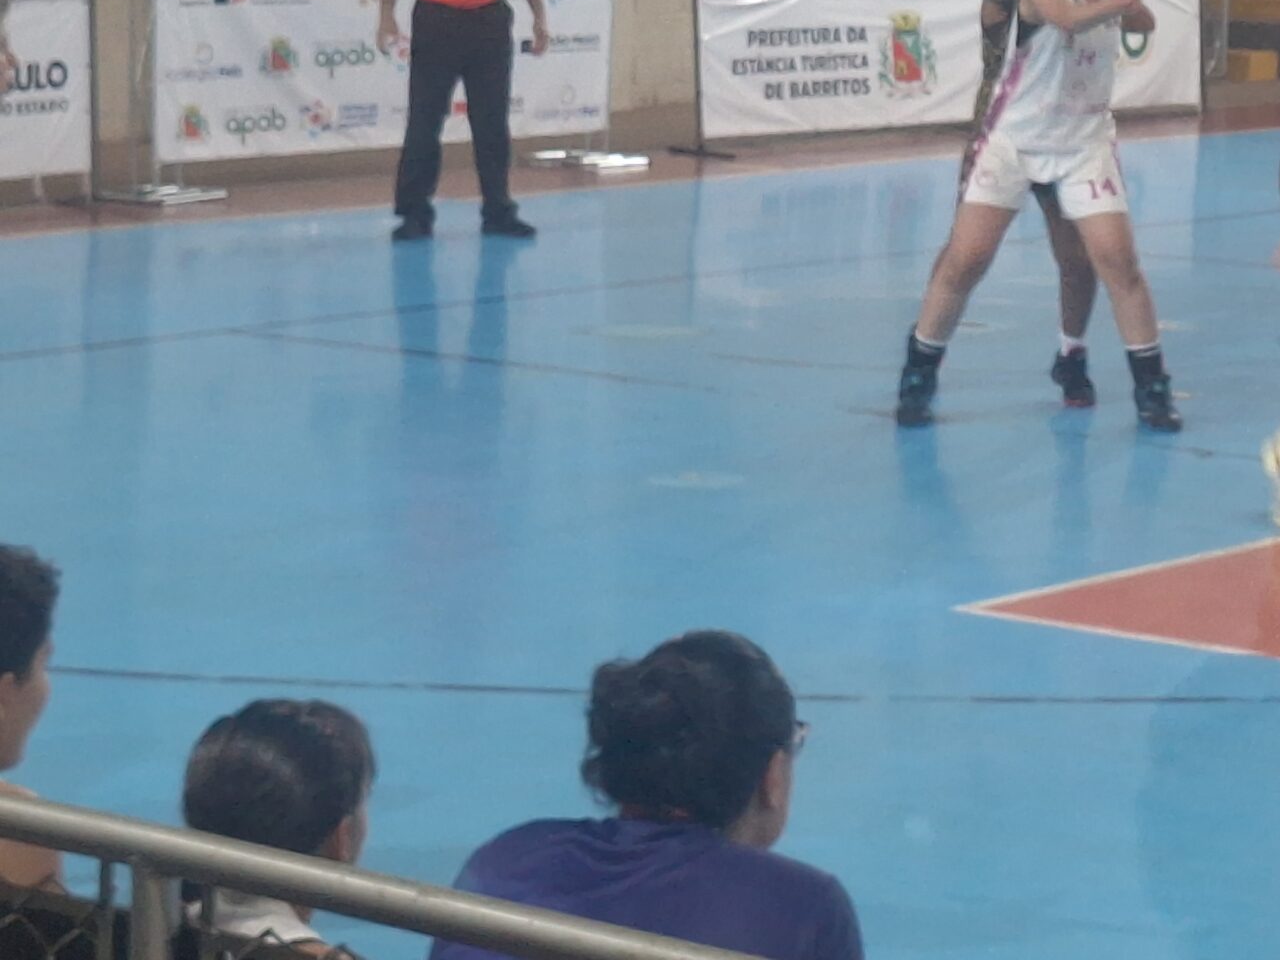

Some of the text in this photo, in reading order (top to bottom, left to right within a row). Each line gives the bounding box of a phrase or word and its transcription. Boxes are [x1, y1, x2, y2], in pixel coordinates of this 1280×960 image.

[747, 26, 868, 48] PREFEITURA DA
[315, 40, 375, 78] apab
[732, 51, 869, 75] ESTÂNCIA TURÍSTICA
[764, 77, 871, 100] DE BARRETOS
[16, 100, 69, 114] ESTADO
[226, 105, 286, 145] apab
[1088, 176, 1117, 200] 14
